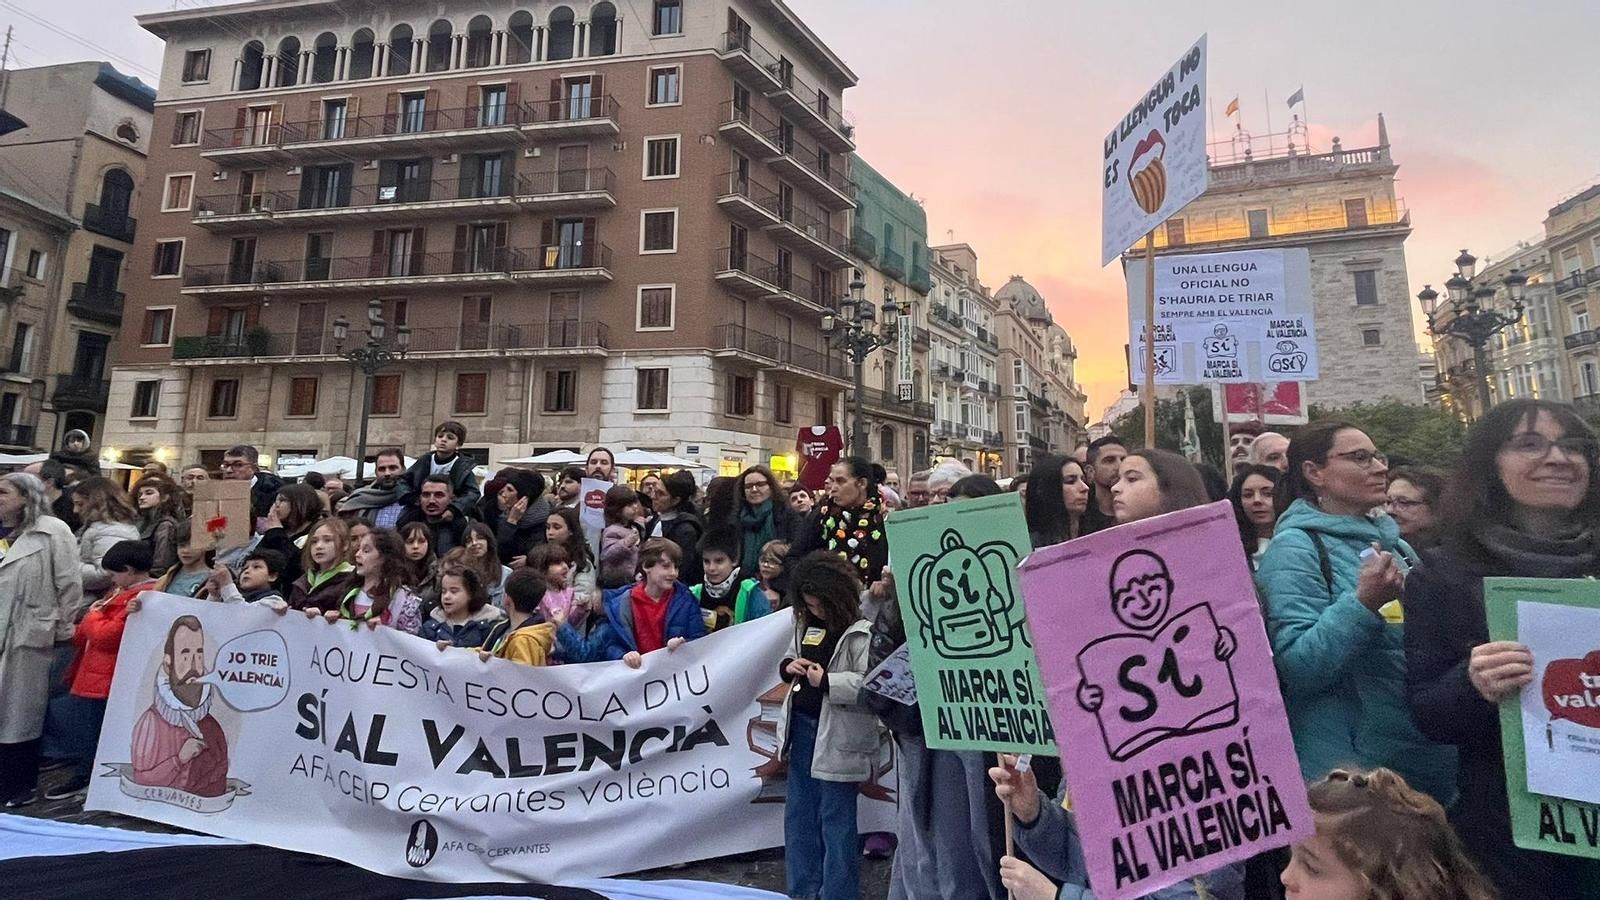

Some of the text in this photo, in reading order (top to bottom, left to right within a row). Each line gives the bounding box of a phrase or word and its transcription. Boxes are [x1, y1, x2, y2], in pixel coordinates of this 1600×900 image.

[1104, 46, 1200, 160] LA LLENGUA NO
[1104, 158, 1120, 188] ES
[1163, 84, 1200, 133] TOCA
[1172, 262, 1258, 275] UNA LLENGUA
[1180, 278, 1250, 290] OFICIAL NO
[1159, 292, 1274, 305] S'HAURIA DE TRIAR
[1160, 310, 1194, 319] SEMPRE
[1196, 309, 1215, 317] AMB
[1217, 309, 1228, 317] EL
[1266, 330, 1276, 338] AL
[1270, 320, 1295, 329] MARCA
[1203, 370, 1212, 378] AL
[1206, 360, 1231, 369] MARCA
[228, 652, 278, 667] JO TRIE
[218, 670, 284, 688] VALENCIÀ!
[310, 645, 710, 722] AQUESTA ESCOLA DIU
[938, 660, 1035, 706] MARCA SÍ
[295, 688, 730, 778] SÍ AL VALENCIÀ
[937, 700, 1056, 746] AL VALENCIÀ
[1112, 725, 1259, 828] MARCA SÍ
[143, 788, 203, 810] CERVANTES
[397, 786, 566, 813] Cervantes
[1111, 775, 1292, 890] AL VALENCIÀ
[1539, 801, 1577, 844] AL
[441, 841, 464, 852] AFA
[487, 843, 551, 858] CERVANTES
